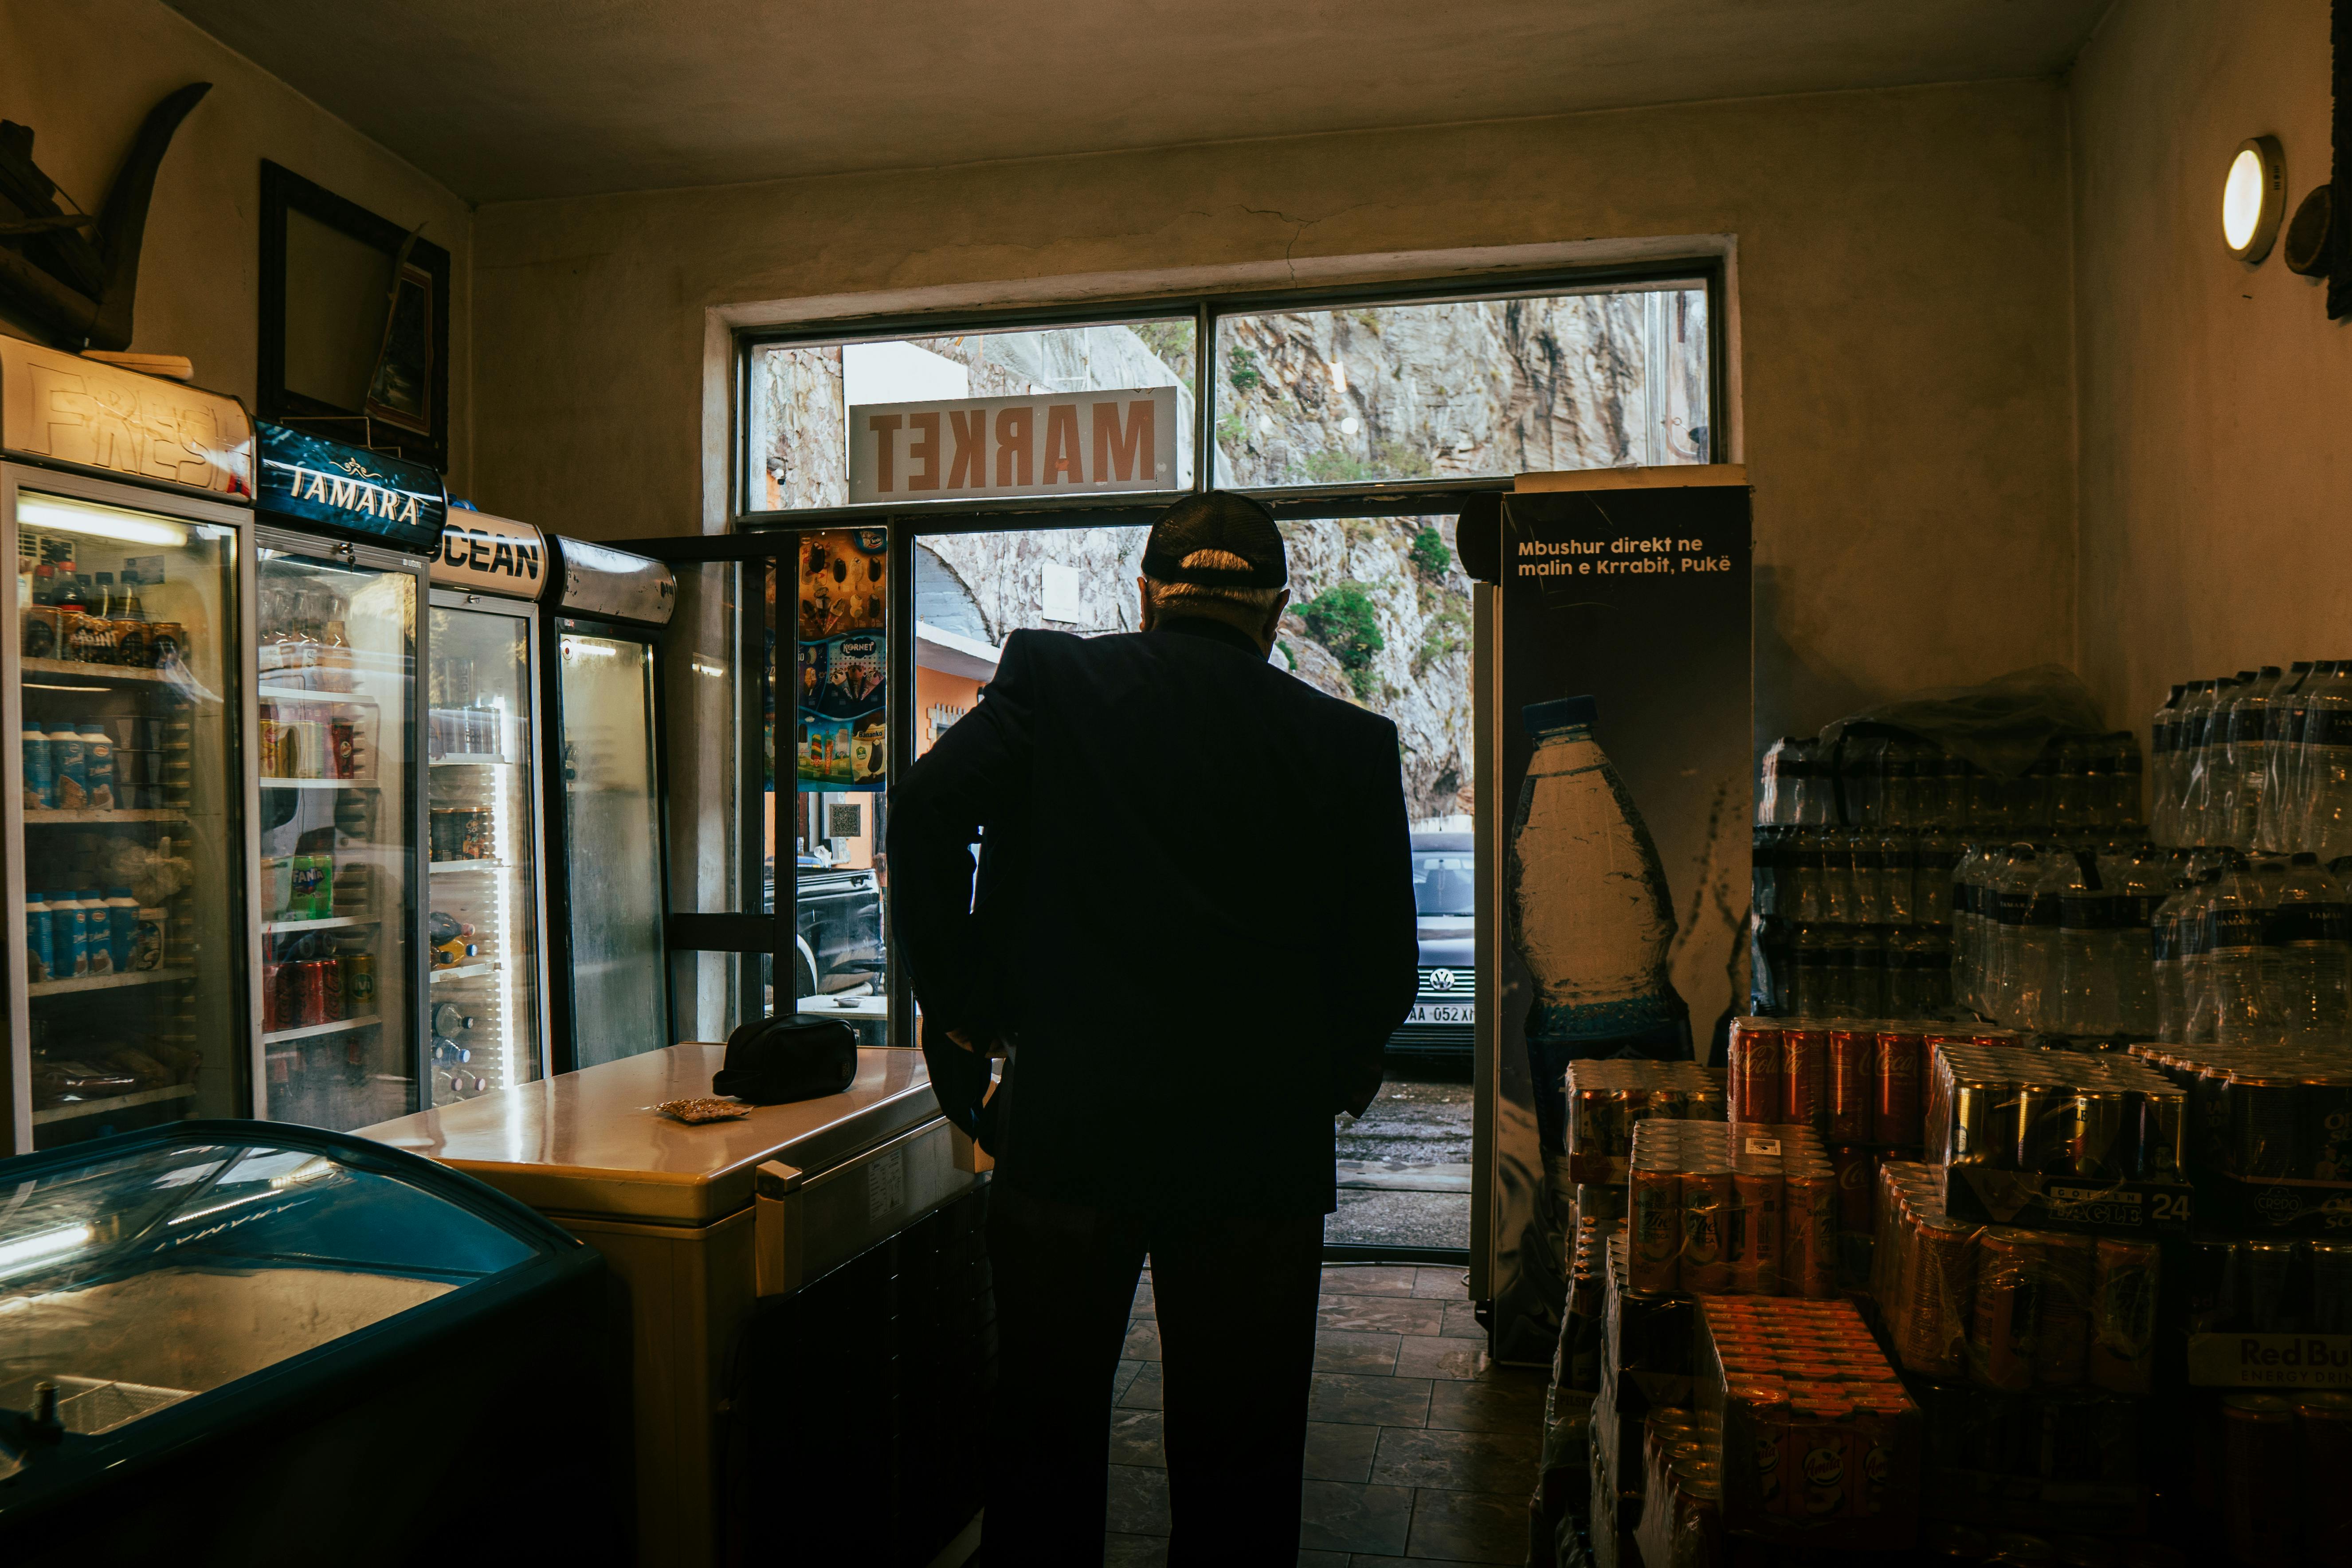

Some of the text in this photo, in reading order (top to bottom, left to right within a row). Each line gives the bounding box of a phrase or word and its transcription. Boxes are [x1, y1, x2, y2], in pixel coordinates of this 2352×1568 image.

[290, 469, 419, 525] TAMARA
[1518, 537, 1703, 556] Mbushur direkt ne
[1518, 556, 1731, 576] malin e Krrabit, Pukë
[843, 641, 874, 654] KORNET
[2217, 918, 2261, 927] TAMARA
[1410, 1007, 1426, 1021] AA
[1434, 1007, 1458, 1021] 052
[2048, 1201, 2143, 1226] EAGLE
[2151, 1194, 2191, 1221] 24
[2258, 1198, 2299, 1211] CRODO
[2241, 1338, 2302, 1366] Red
[2242, 1370, 2308, 1382] ENERGY
[1803, 1457, 1841, 1478] Amita
